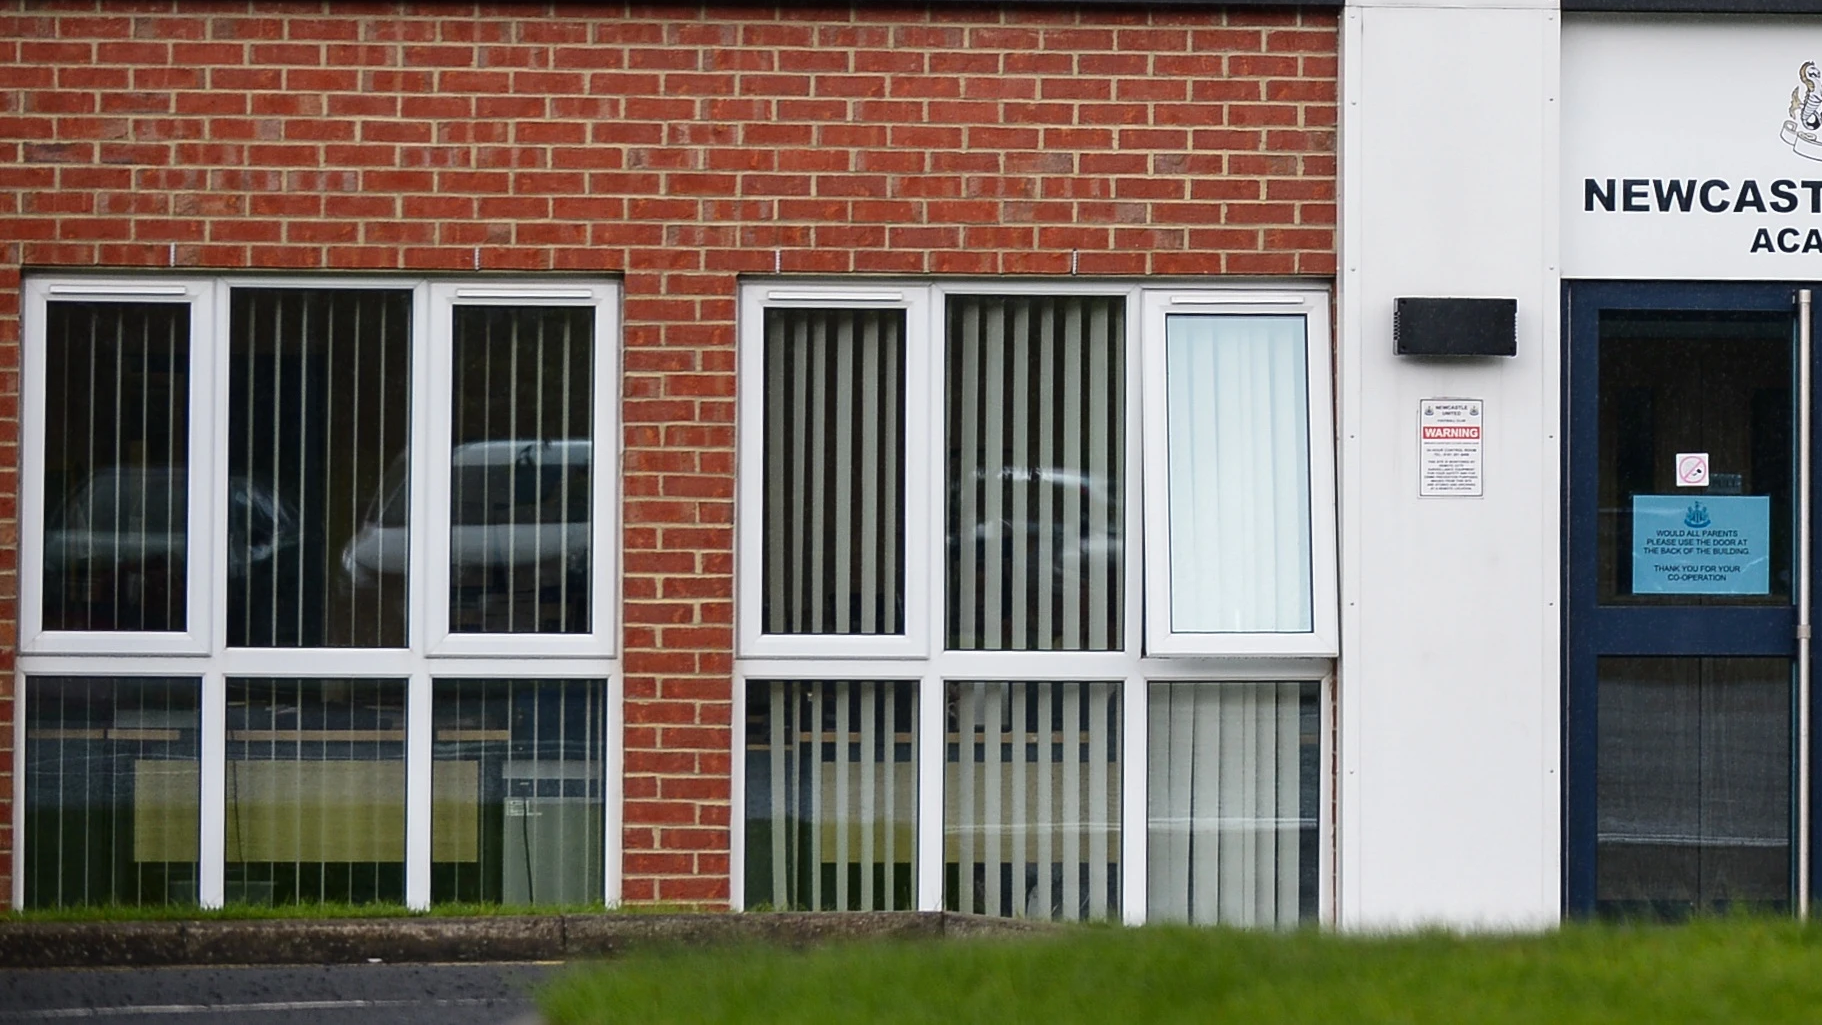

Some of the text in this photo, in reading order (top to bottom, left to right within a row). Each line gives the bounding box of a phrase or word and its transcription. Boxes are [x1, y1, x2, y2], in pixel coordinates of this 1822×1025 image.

[1424, 428, 1479, 438] WARNING
[1646, 538, 1676, 546] PLEASE
[1677, 538, 1694, 546] USE
[1696, 538, 1711, 546] THE
[1643, 547, 1659, 555] THE
[1660, 547, 1681, 555] BACK
[1683, 547, 1694, 555] OF
[1696, 547, 1711, 555] THE
[1653, 564, 1680, 572] THANK
